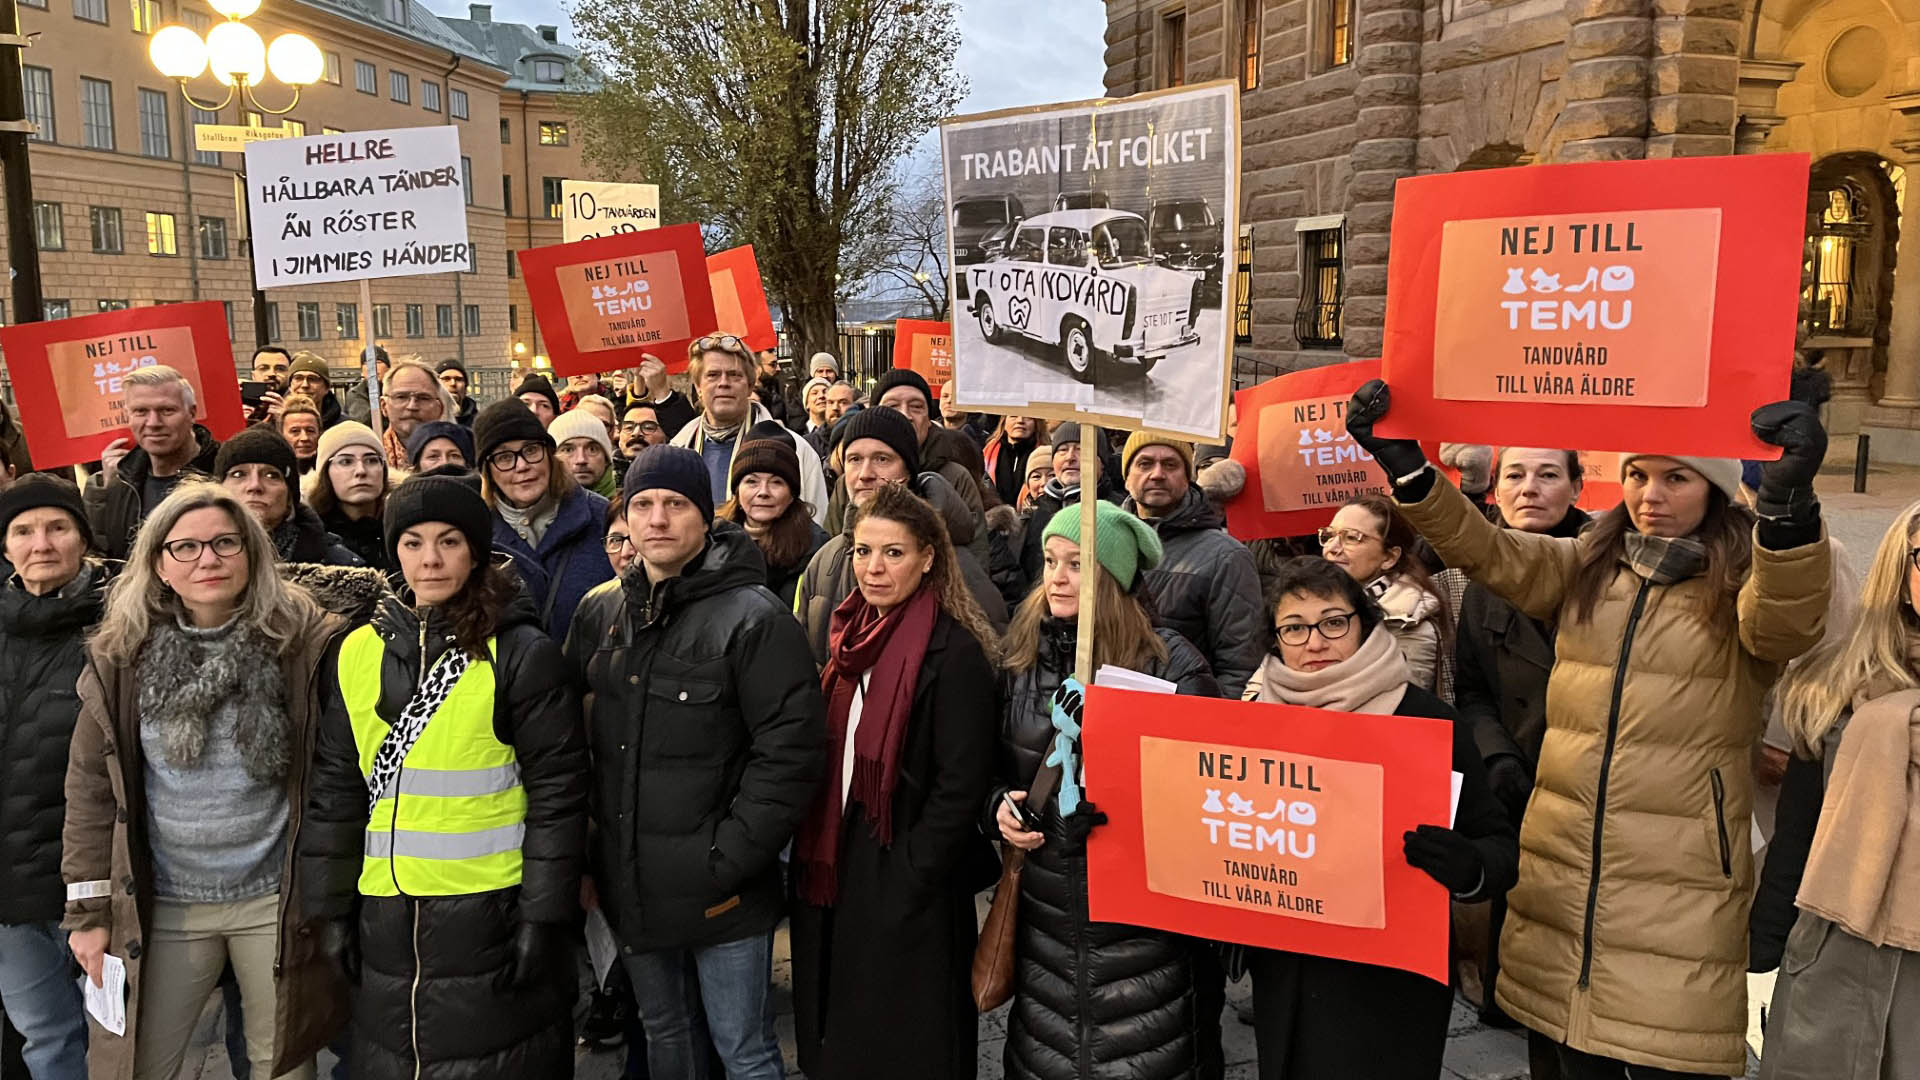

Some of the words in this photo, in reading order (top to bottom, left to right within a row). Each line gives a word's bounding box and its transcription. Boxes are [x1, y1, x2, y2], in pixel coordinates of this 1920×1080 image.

[306, 138, 396, 165] HELLRE
[960, 143, 1077, 181] TRABANT
[1083, 132, 1113, 171] ÅT
[1119, 127, 1213, 168] FOLKET
[262, 176, 374, 203] HÅLLBARA
[378, 166, 460, 193] TÄNDER
[281, 212, 312, 240] ÄN
[323, 209, 416, 235] RÖSTER
[1501, 226, 1554, 255] NEJ
[1569, 222, 1643, 253] TILL
[272, 259, 278, 276] I
[284, 251, 372, 275] JIMMIES
[383, 241, 467, 267] HÄNDER
[584, 263, 610, 282] NEJ
[615, 260, 648, 277] TILL
[593, 295, 652, 316] TEMU
[1501, 300, 1632, 331] TEMU
[608, 318, 646, 332] TANDVÅRD
[85, 342, 113, 359] NEJ
[119, 335, 158, 352] TILL
[601, 337, 616, 347] TILL
[617, 333, 635, 345] VÅRA
[637, 330, 662, 342] ÄLDRE
[930, 337, 946, 346] NEJ
[1523, 342, 1608, 366] TANDVÅRD
[95, 378, 123, 395] TE
[1496, 375, 1528, 393] TILL
[1534, 371, 1575, 395] VÅRA
[1580, 373, 1635, 397] ÄLDRE
[100, 416, 114, 428] TILL
[1294, 403, 1326, 423] NEJ
[1316, 469, 1367, 486] TANDVÅRD
[1302, 490, 1322, 505] TILL
[1199, 752, 1247, 781] NEJ
[1259, 758, 1321, 792] TILL
[1201, 817, 1315, 859] TEMU
[1223, 859, 1298, 886] TANDVÅRD
[1202, 880, 1231, 900] TILL
[1235, 884, 1272, 907] VÅRA
[1277, 890, 1325, 915] ÄLDRE
